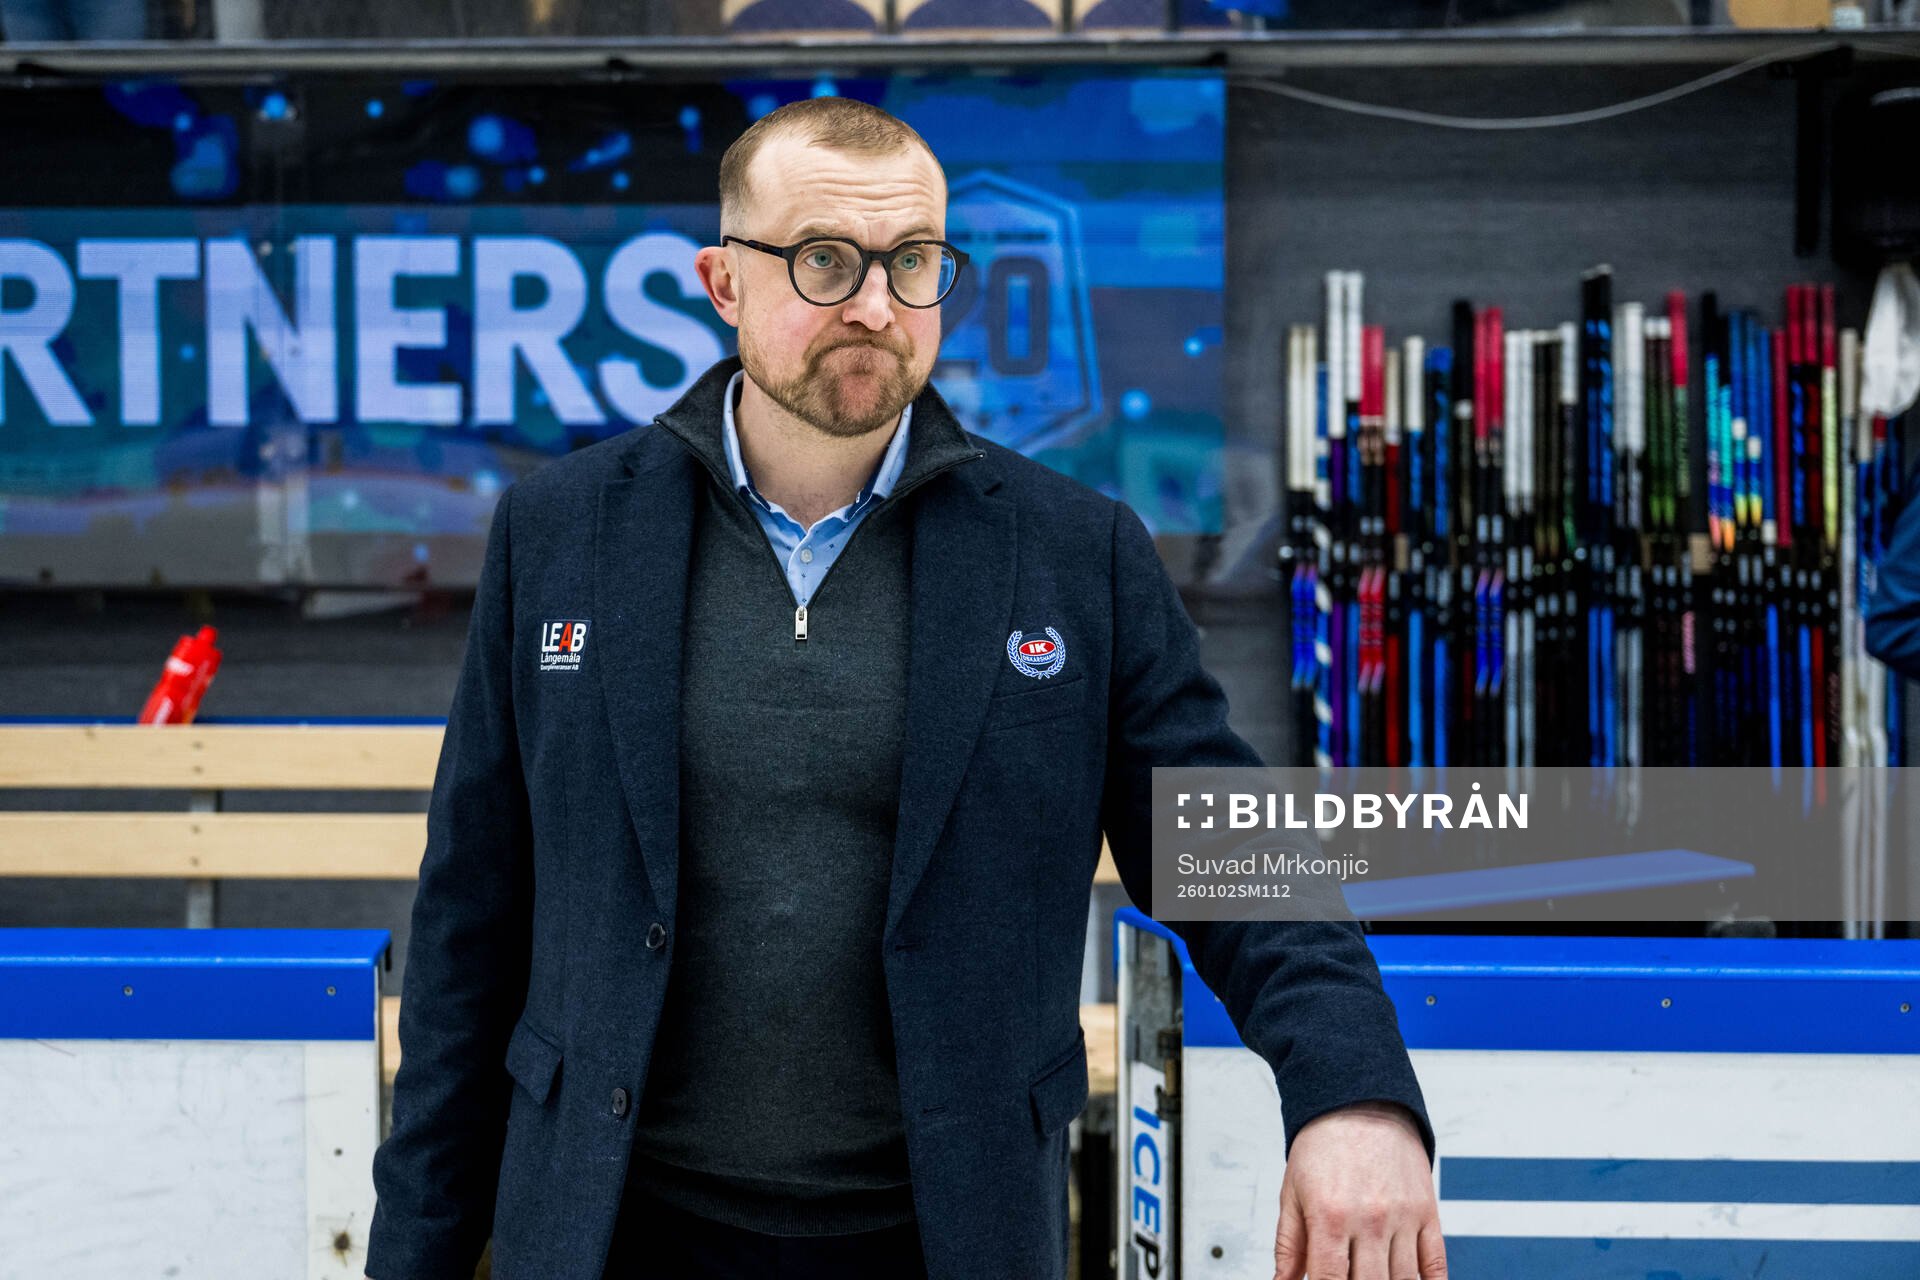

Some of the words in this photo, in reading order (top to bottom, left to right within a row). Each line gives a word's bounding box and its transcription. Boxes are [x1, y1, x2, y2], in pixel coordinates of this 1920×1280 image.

[0, 232, 725, 427] RTNERS
[541, 622, 587, 653] LEAB
[1028, 642, 1048, 654] IK
[540, 653, 581, 665] Långemåla
